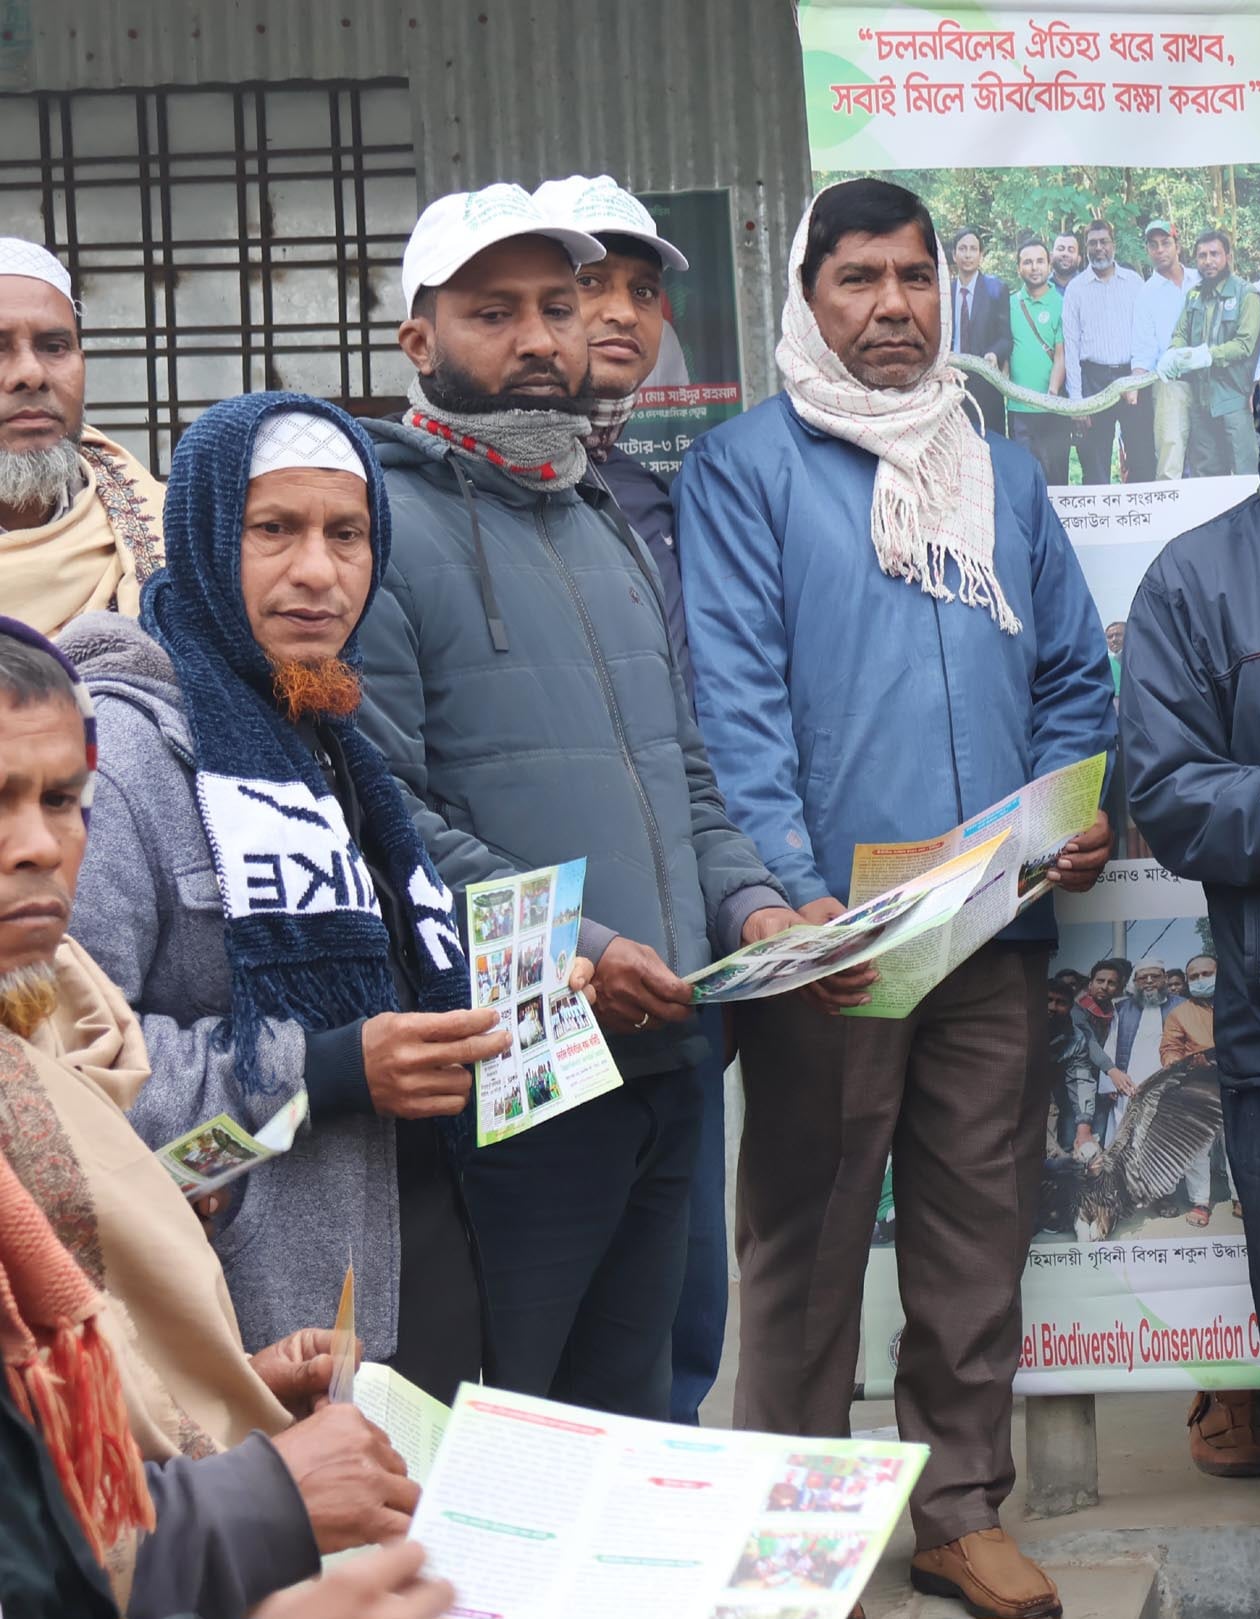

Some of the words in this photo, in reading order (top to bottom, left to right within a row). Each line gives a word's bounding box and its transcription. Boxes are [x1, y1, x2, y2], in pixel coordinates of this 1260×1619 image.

[859, 19, 1015, 61] “চলনবিলের
[1025, 19, 1101, 60] ঐতিহ্য
[1110, 33, 1154, 61] ধরে
[1161, 33, 1235, 66] রাখব,
[831, 78, 896, 116] সবাই
[904, 72, 964, 114] মিলে
[971, 65, 1105, 114] জীববৈচিত্র্য
[1113, 83, 1162, 114] রক্ষা
[1058, 494, 1097, 508] করেন
[1101, 494, 1121, 507] বন
[1115, 510, 1152, 527] করিম
[1131, 1245, 1168, 1264] বিপন্ন
[1174, 1246, 1208, 1264] শকুন
[1041, 1320, 1134, 1373] Biodiversity
[1139, 1315, 1244, 1363] Conservation
[1248, 1312, 1260, 1358] C
